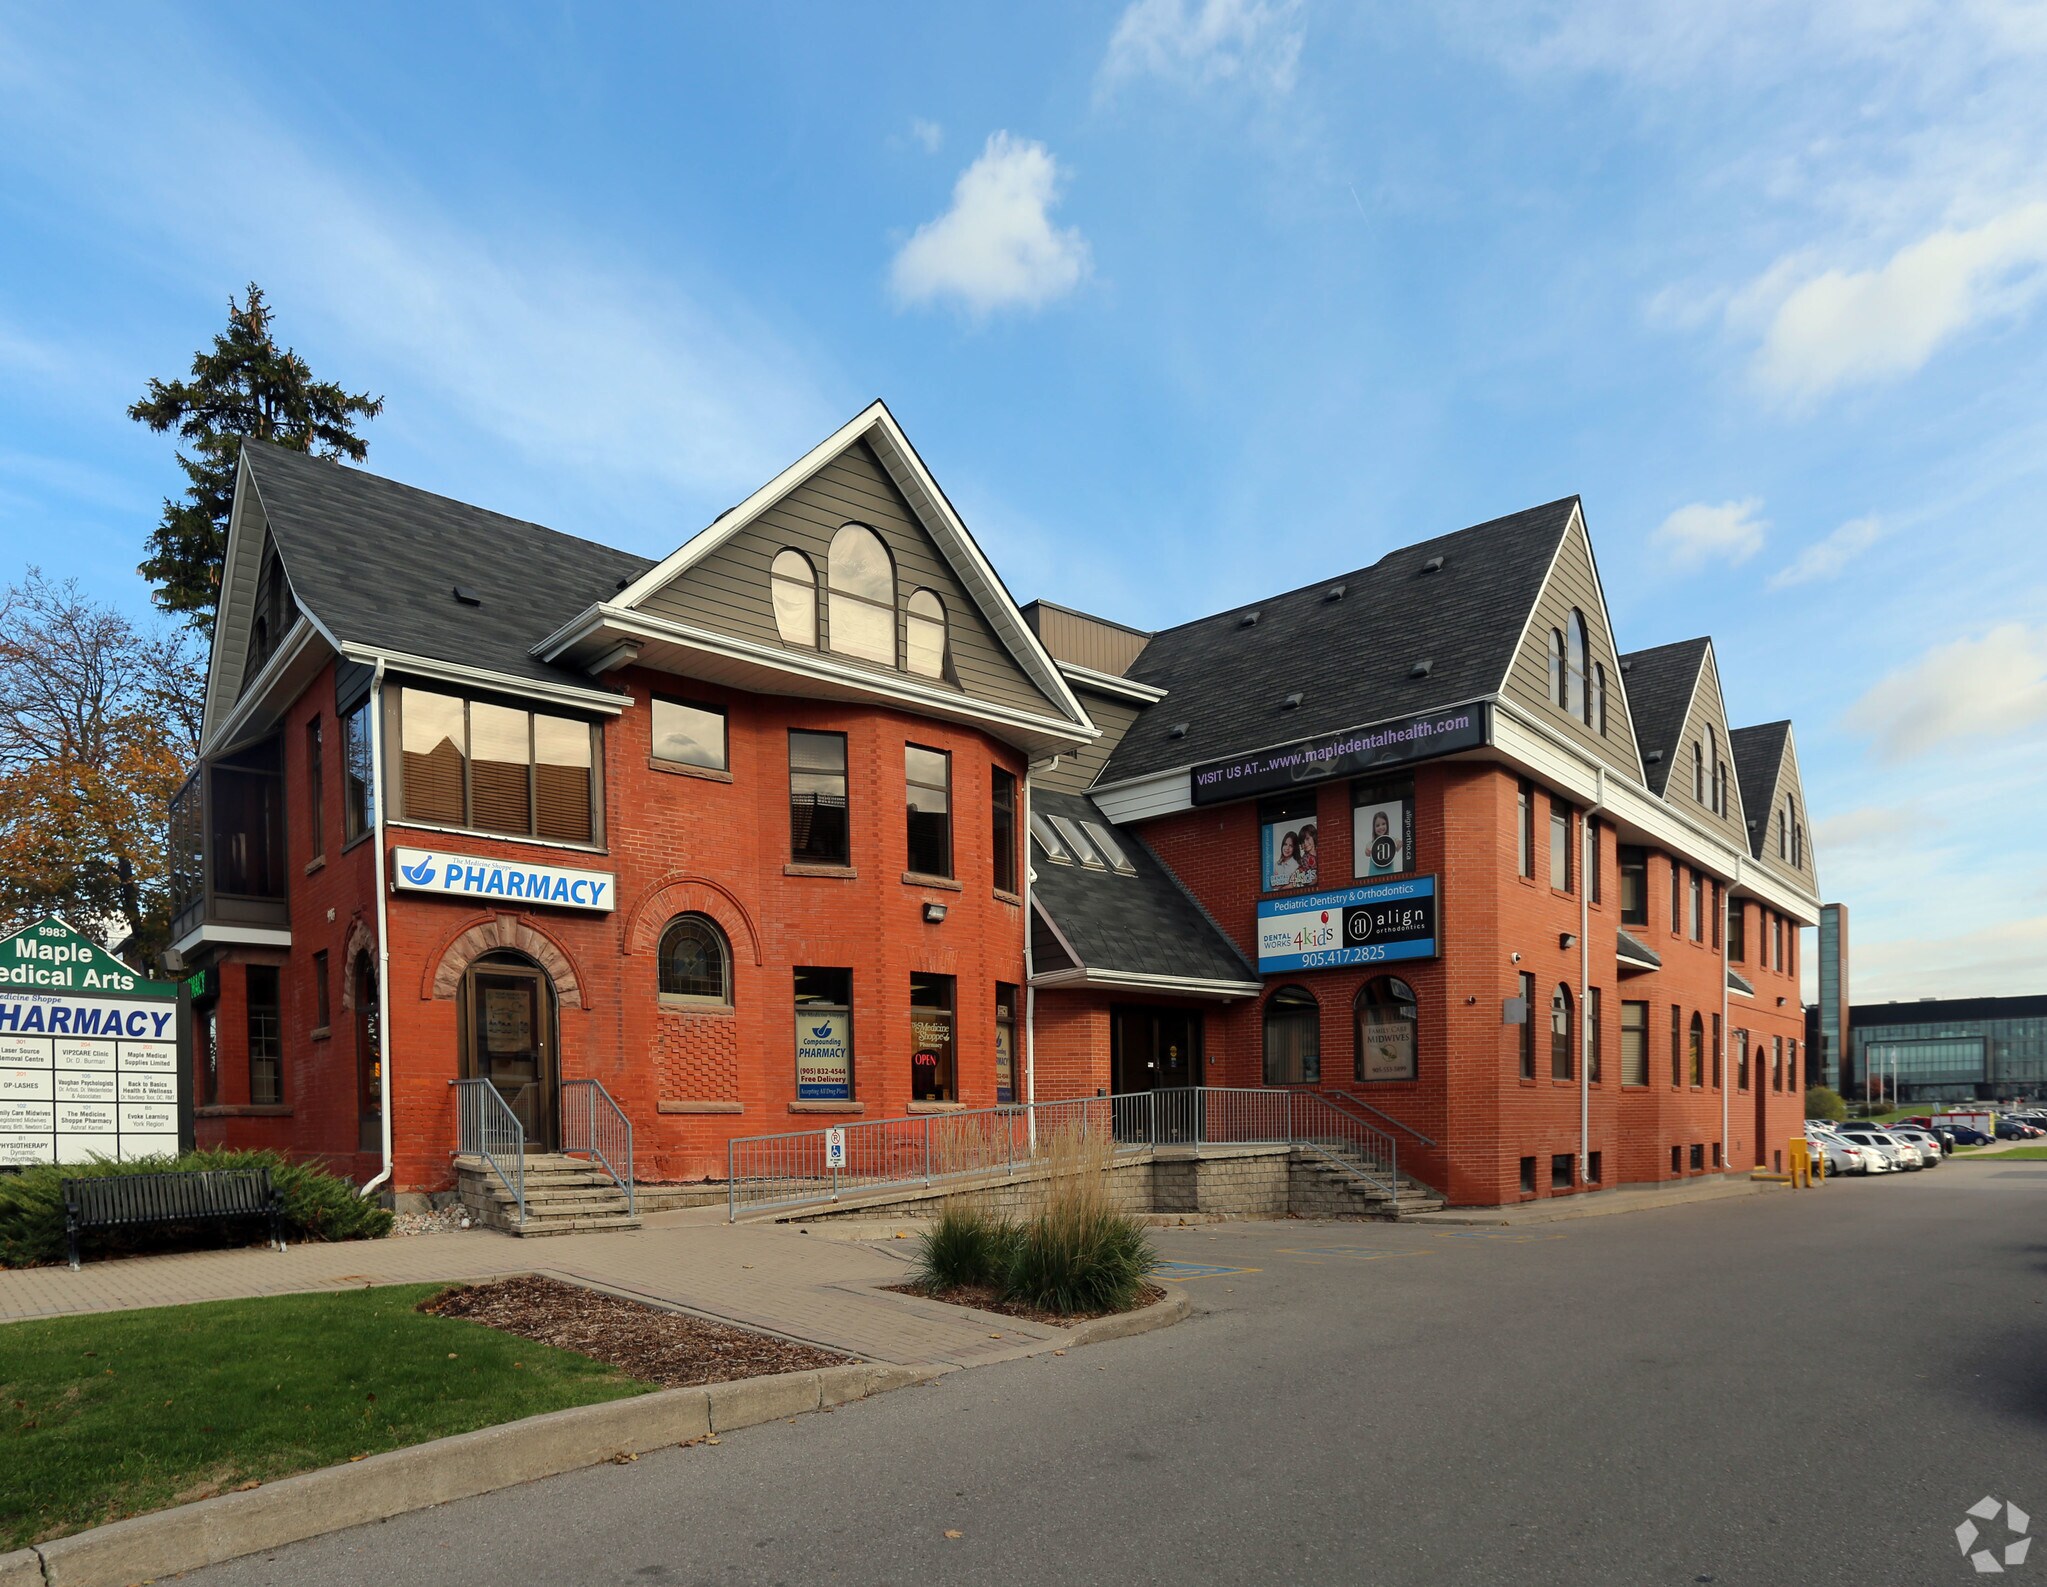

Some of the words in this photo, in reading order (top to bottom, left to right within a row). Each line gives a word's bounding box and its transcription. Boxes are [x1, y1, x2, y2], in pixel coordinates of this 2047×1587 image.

[1197, 770, 1224, 786] VISIT
[1226, 766, 1242, 780] US
[452, 857, 464, 865] The
[465, 859, 491, 868] Medicine
[491, 862, 512, 871] Shoppe
[444, 864, 607, 906] PHARMACY
[1274, 899, 1309, 911] Pediatric
[1310, 893, 1347, 907] Dentistry
[1349, 891, 1355, 901] &
[1356, 884, 1414, 900] Orthodontics
[1377, 908, 1424, 926] align
[38, 926, 67, 938] 9983
[1376, 923, 1425, 934] orthodontics
[1264, 932, 1291, 942] DENTAL
[1293, 927, 1334, 951] 4kids
[1264, 939, 1291, 949] WORKS
[16, 937, 93, 966] Maple
[1302, 945, 1385, 967] 905.417.2825
[0, 963, 73, 987] edical
[82, 968, 135, 991] Arts
[0, 993, 29, 1002] edicine
[31, 994, 62, 1004] Shoppe
[0, 1003, 172, 1038] HARMACY
[915, 1022, 949, 1033] Medicine
[918, 1031, 944, 1041] Shoppe
[1367, 1034, 1410, 1043] MIDWIVES
[803, 1038, 841, 1046] Compounding
[19, 1047, 40, 1055] Source
[128, 1051, 145, 1059] Maple
[799, 1048, 846, 1058] PHARMACY
[24, 1055, 44, 1063] Centre
[125, 1059, 149, 1067] Supplies
[915, 1053, 936, 1065] OPEN
[58, 1079, 80, 1087] Vaughan
[80, 1080, 114, 1088] Psychologists
[817, 1076, 846, 1084] Delivery
[61, 1117, 82, 1125] Shoppe
[84, 1118, 112, 1126] Pharmacy
